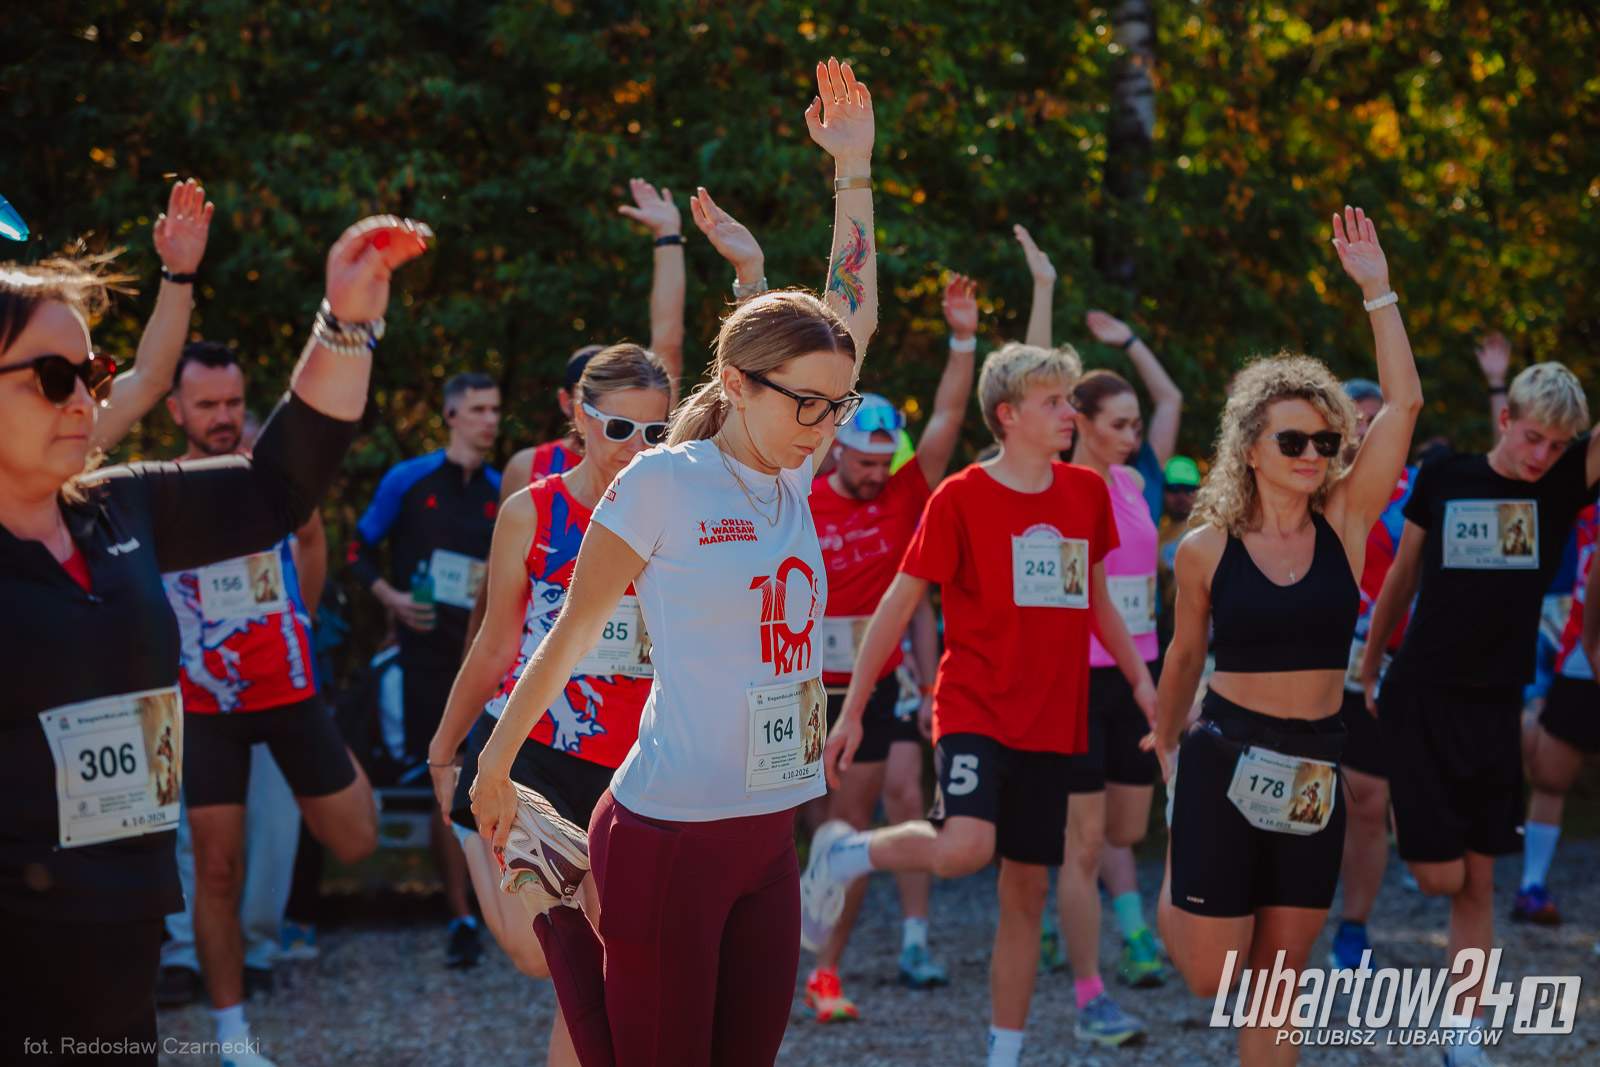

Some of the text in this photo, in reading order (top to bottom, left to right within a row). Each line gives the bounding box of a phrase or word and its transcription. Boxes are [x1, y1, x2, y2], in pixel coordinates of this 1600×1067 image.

[711, 526, 755, 535] WARSAW
[721, 518, 753, 526] ORLEN
[698, 534, 758, 545] MARATHON
[1456, 522, 1488, 540] 241
[1025, 560, 1056, 577] 242
[212, 577, 242, 592] 156
[764, 716, 794, 745] 164
[79, 742, 136, 782] 306
[946, 753, 979, 796] 5
[1249, 773, 1286, 799] 178
